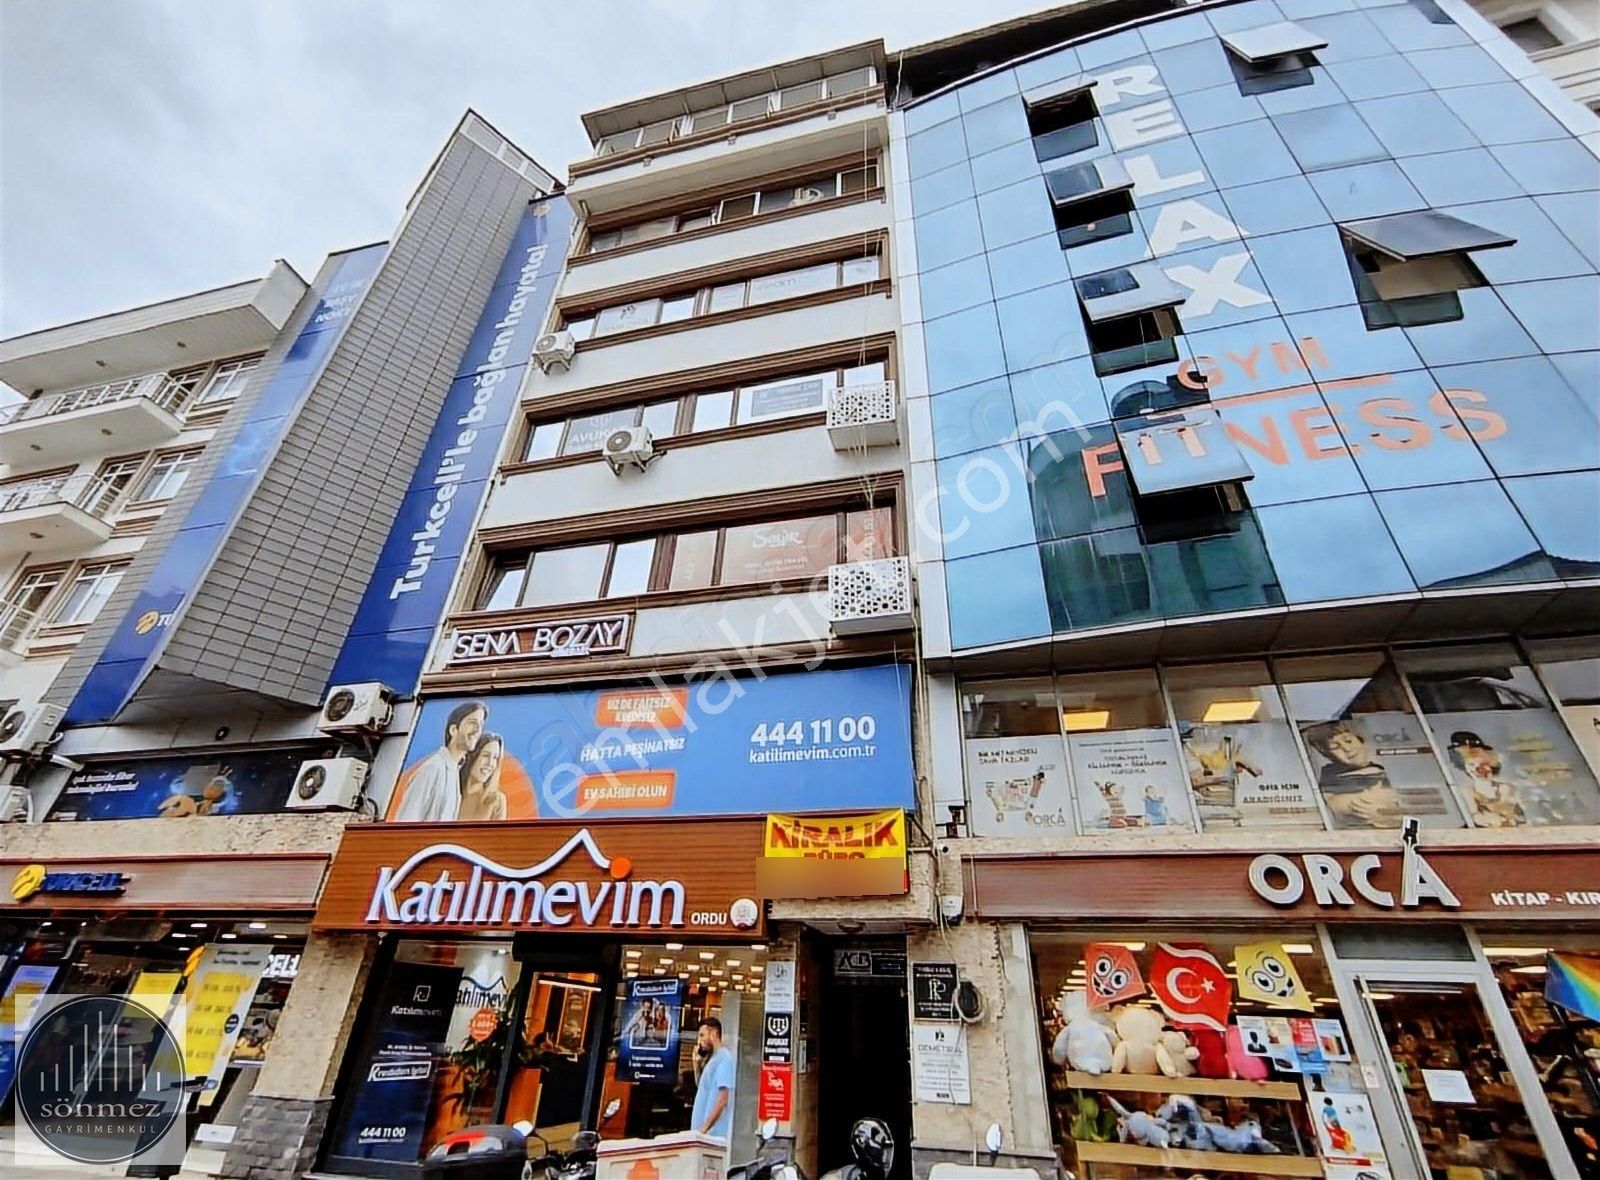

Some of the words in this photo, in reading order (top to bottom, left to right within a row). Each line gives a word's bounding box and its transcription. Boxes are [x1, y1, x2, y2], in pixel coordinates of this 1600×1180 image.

[1094, 64, 1272, 320] RELAX
[1177, 336, 1329, 391] GYM
[1081, 388, 1509, 498] FITNESS
[454, 631, 521, 658] SENA
[534, 620, 623, 651] BOZAY
[750, 720, 804, 747] 444
[810, 718, 833, 744] 11
[838, 715, 876, 742] 00
[580, 745, 622, 762] HATTA
[749, 744, 876, 763] katilimevim.com.tr
[636, 785, 668, 798] OLUN
[770, 818, 898, 848] KİRALIK
[1248, 837, 1461, 908] ORCA
[366, 856, 686, 926] Katılımevim
[690, 912, 727, 925] ORDU
[1490, 890, 1551, 905] KİTAP
[360, 1127, 381, 1138] 444
[392, 1127, 406, 1138] 00
